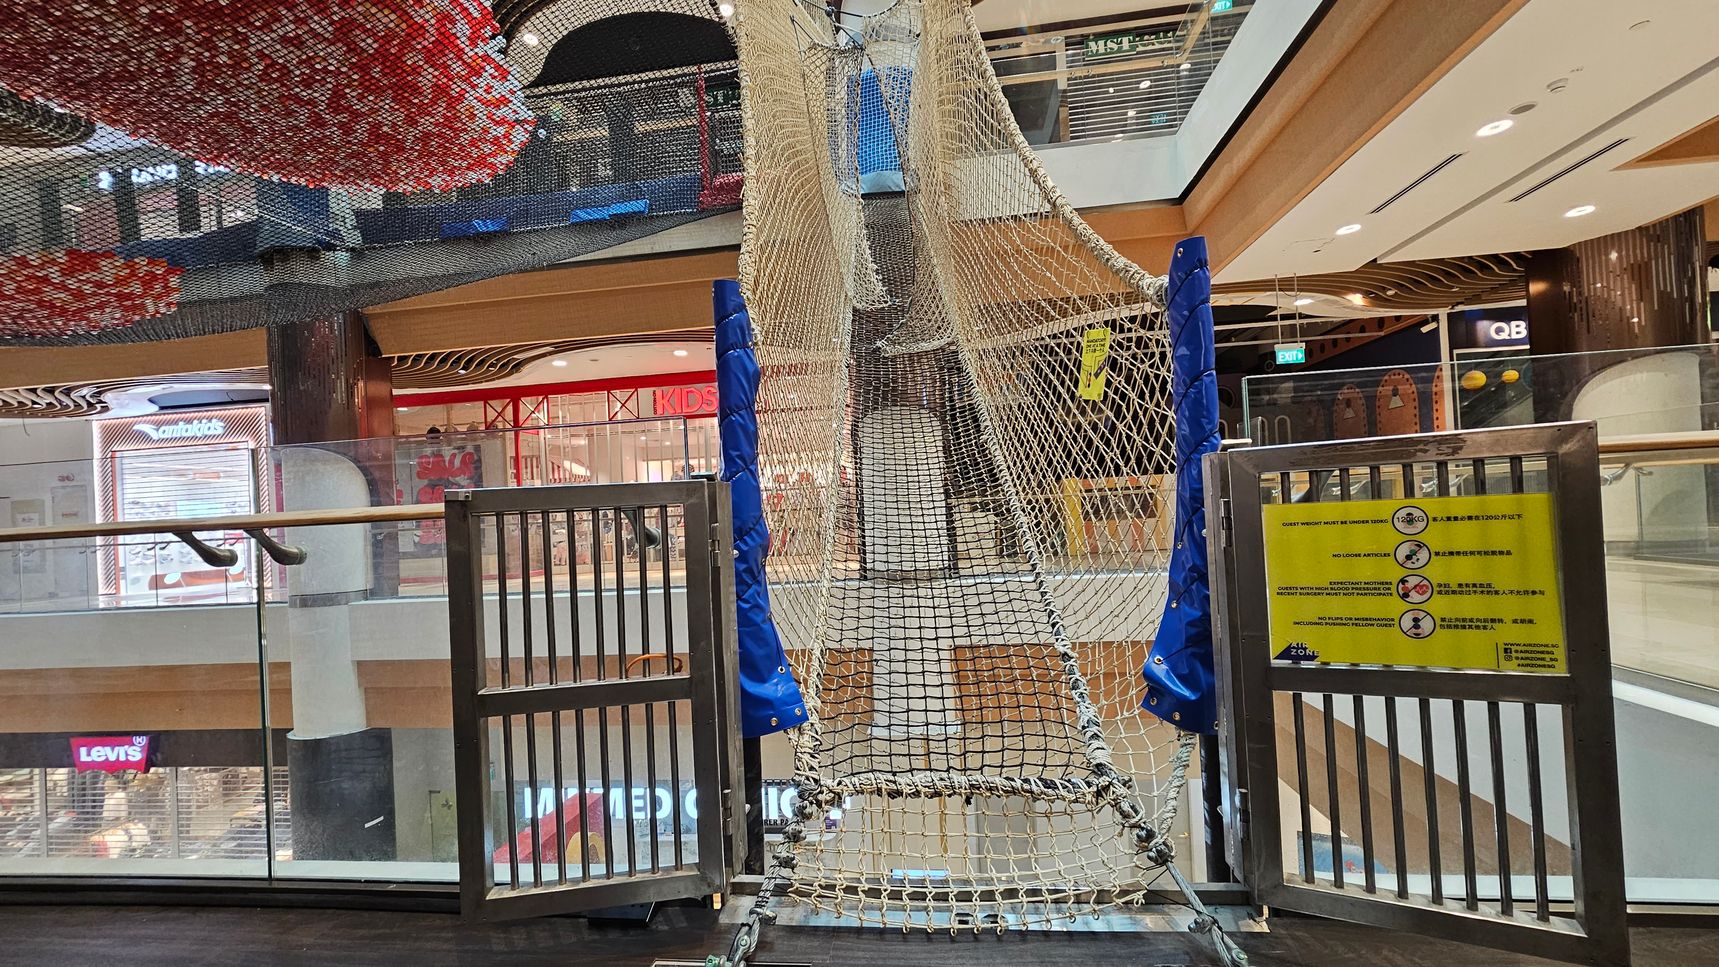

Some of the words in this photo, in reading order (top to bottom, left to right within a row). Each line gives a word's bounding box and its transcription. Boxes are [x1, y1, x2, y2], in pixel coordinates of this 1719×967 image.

[1088, 36, 1134, 55] MST
[1490, 320, 1528, 339] QB
[1278, 352, 1298, 362] EXIT
[656, 386, 718, 415] KIDS
[158, 419, 225, 439] antakids
[1290, 648, 1320, 656] ZONE
